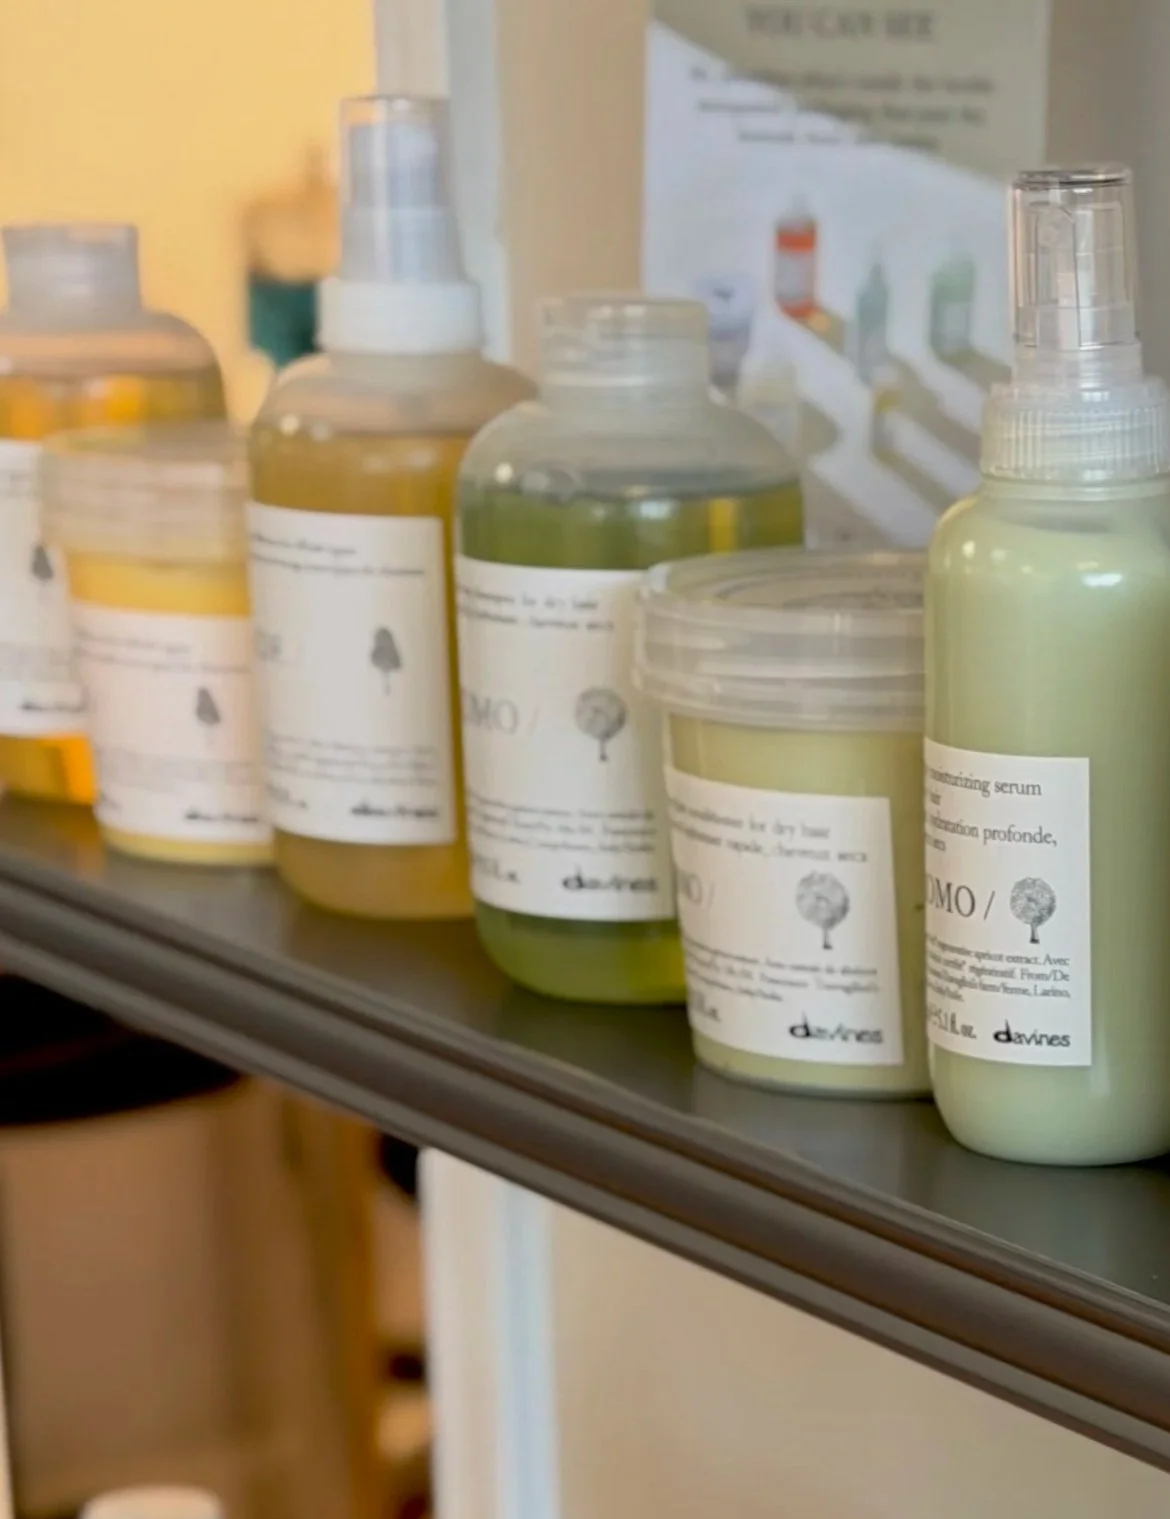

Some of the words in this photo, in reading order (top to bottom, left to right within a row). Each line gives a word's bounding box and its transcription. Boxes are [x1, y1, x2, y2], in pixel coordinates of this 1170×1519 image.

[994, 780, 1042, 797] serum
[983, 823, 1057, 847] profonde,
[992, 1018, 1071, 1048] davines
